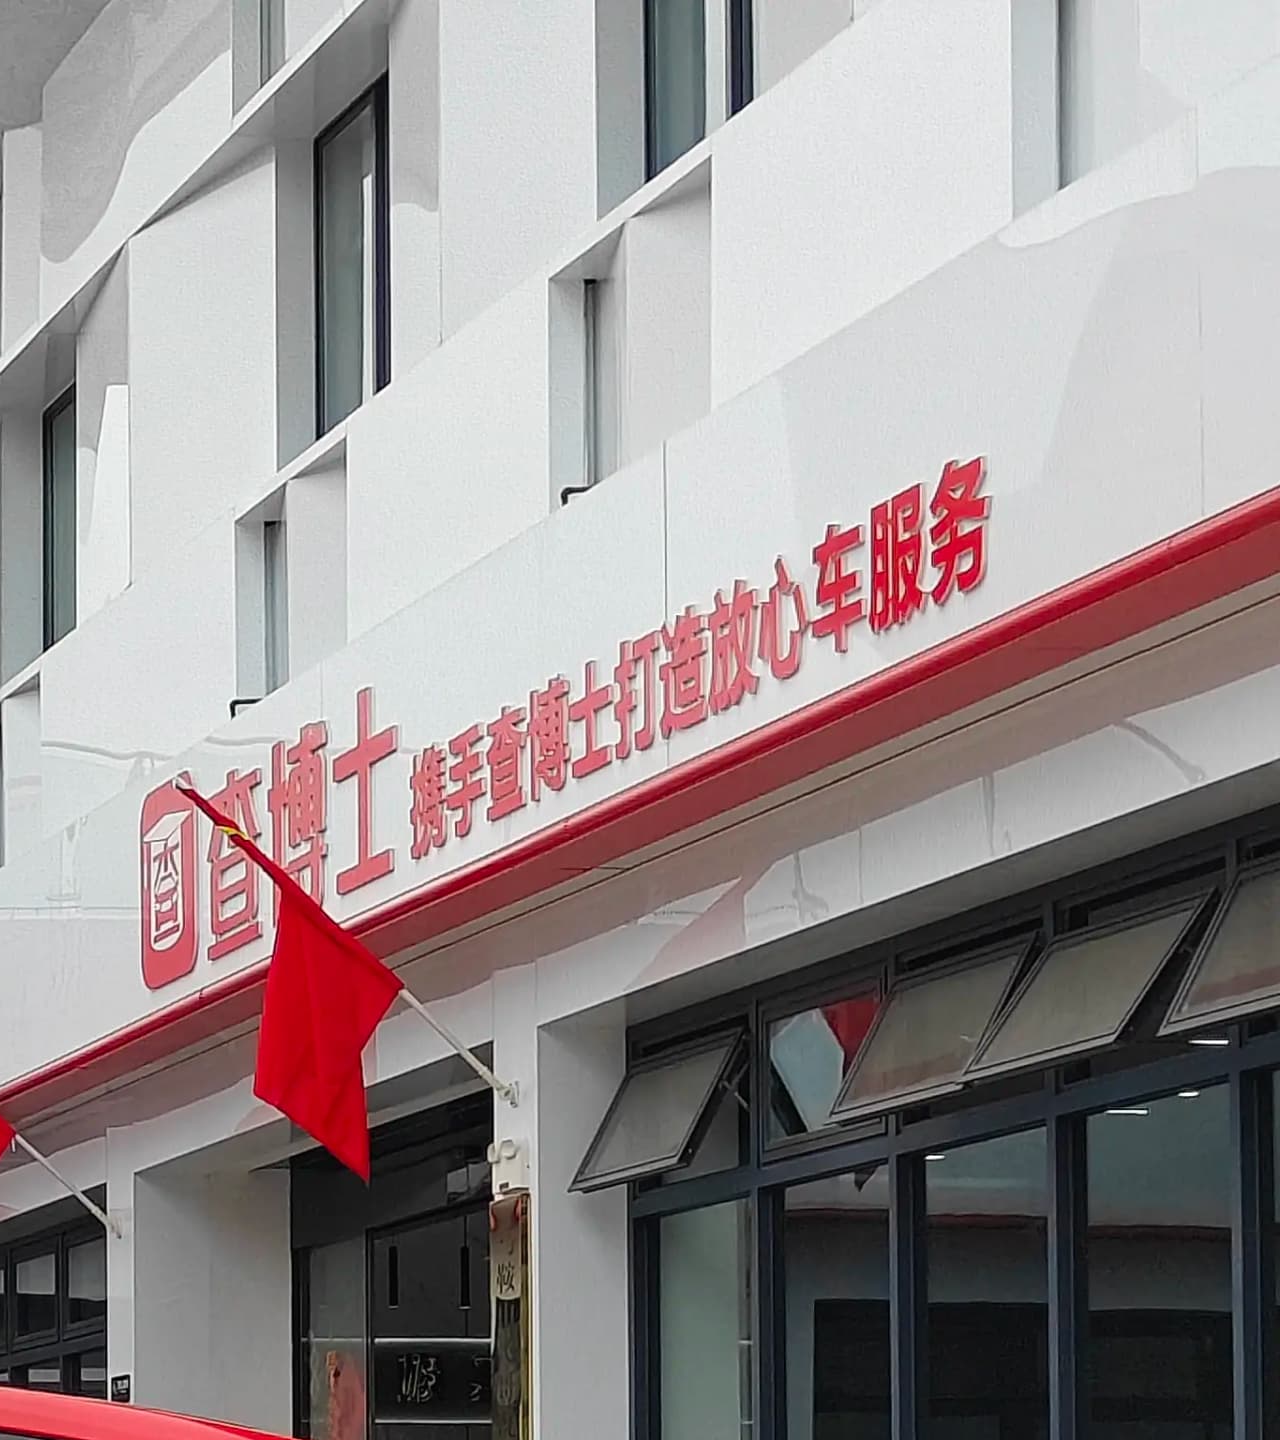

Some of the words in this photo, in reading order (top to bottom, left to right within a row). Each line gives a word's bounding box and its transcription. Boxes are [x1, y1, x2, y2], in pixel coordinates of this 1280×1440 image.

[207, 687, 397, 963] 查博士
[410, 457, 987, 860] 携手查博士打造放心车服务
